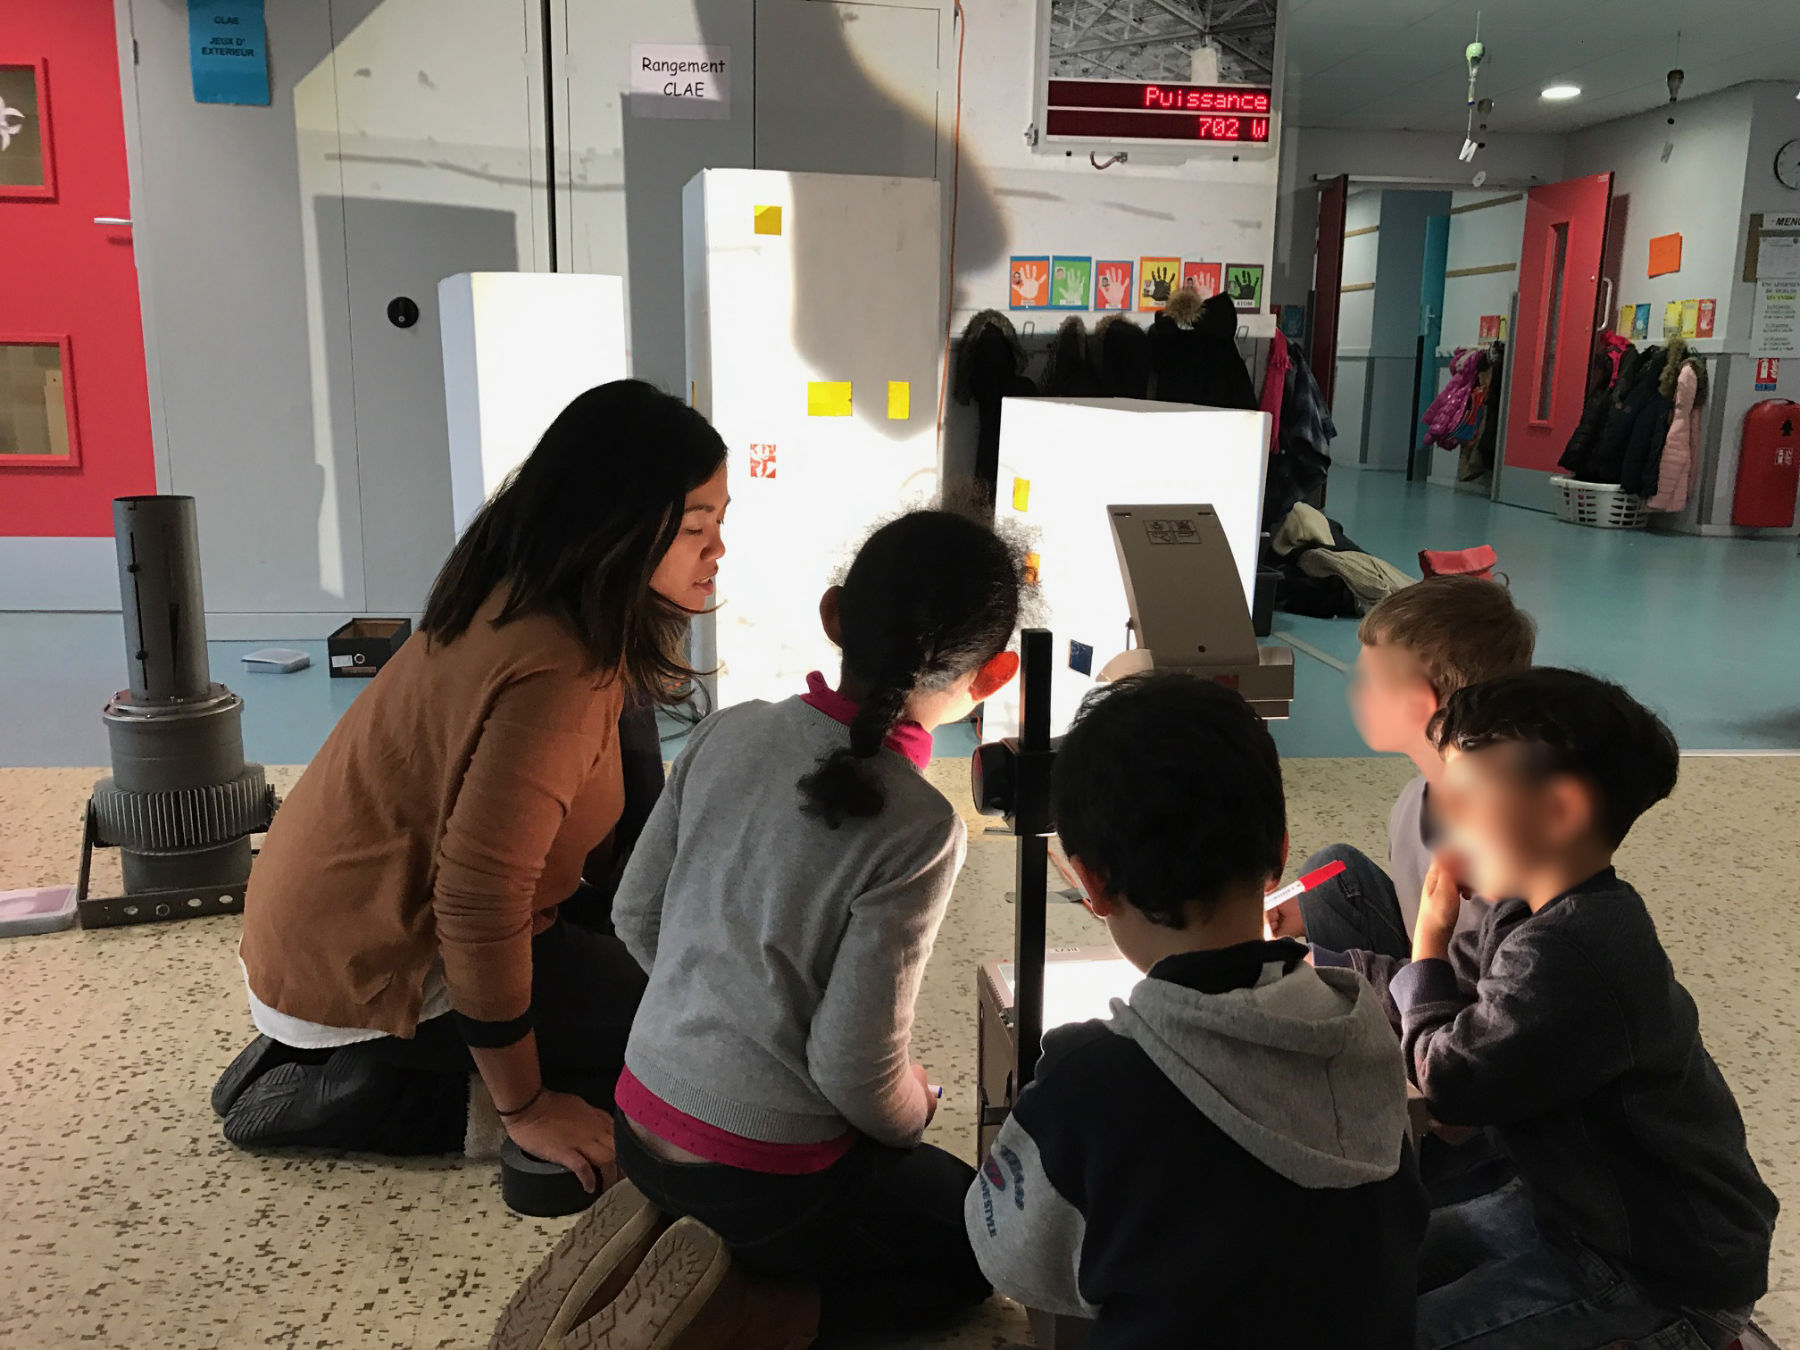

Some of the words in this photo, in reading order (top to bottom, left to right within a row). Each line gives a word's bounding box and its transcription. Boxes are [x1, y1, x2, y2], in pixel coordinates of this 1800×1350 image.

[213, 15, 240, 25] CLAE
[209, 37, 233, 46] JEUX
[201, 47, 255, 57] EXTERIEUR
[642, 56, 726, 77] Rangement
[663, 81, 705, 97] CLAE
[1144, 86, 1268, 110] Puissance
[1199, 117, 1239, 138] 702
[1252, 118, 1267, 139] W
